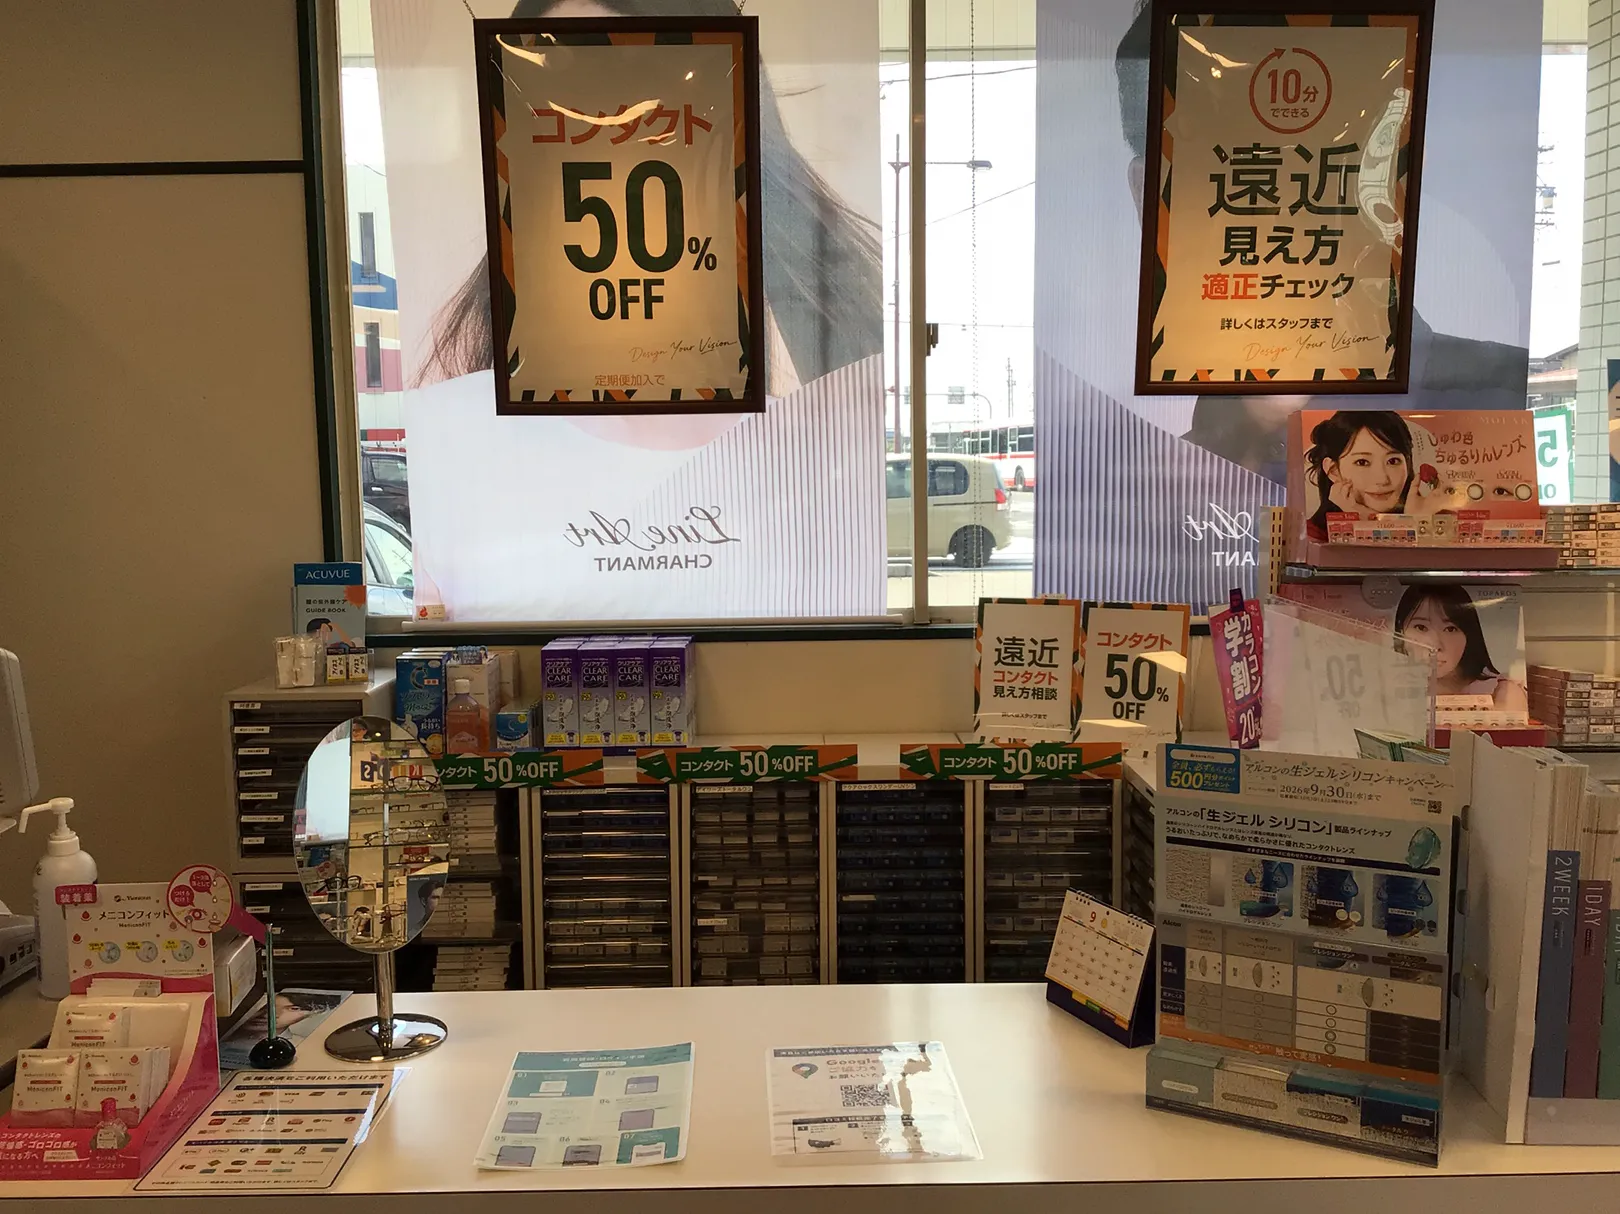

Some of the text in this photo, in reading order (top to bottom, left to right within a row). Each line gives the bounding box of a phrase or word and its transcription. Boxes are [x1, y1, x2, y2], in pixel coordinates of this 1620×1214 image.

[1267, 69, 1319, 104] 10分
[1270, 107, 1311, 119] でできる
[531, 103, 713, 146] コンタクト
[1207, 142, 1362, 218] 遠近
[560, 159, 718, 274] 50%
[1218, 224, 1344, 267] 見え方
[1201, 273, 1355, 301] 適正チェック
[588, 278, 666, 321] OFF
[1220, 316, 1334, 331] 詳しくはスタッフまで
[630, 337, 738, 363] Design Your Vision
[1243, 333, 1381, 362] Design Your Vision
[594, 374, 665, 387] 定期便加入で
[1434, 434, 1527, 465] ちゅるりんレンズ
[305, 568, 351, 580] ACUVUE
[1097, 631, 1173, 651] コンタクト
[993, 636, 1060, 669] 遠近
[1223, 614, 1252, 701] 学割
[1240, 610, 1263, 695] カラコン
[547, 666, 572, 674] CLEAR
[547, 674, 573, 682] CARE
[583, 667, 609, 675] CLEAR
[619, 667, 644, 675] CLEAR
[654, 666, 680, 674] CLEAR
[654, 674, 681, 682] CARE
[993, 670, 1059, 686] コンタクト
[1104, 653, 1170, 703] 50%
[583, 675, 610, 683] CARE
[619, 675, 645, 683] CARE
[993, 685, 1058, 701] 見え方相談
[1112, 701, 1147, 721] OFF
[680, 760, 734, 773] コンタクト
[943, 756, 997, 770] コンタクト
[437, 767, 477, 779] ンタクト
[1245, 763, 1449, 790] アルコンの生ジェルシリコンキャンペーン
[1279, 783, 1383, 803] 2026年9月30日(水)まで
[1552, 855, 1573, 917] 2WEEK
[98, 909, 170, 921] メニコンフィット
[1089, 910, 1097, 923] 9
[826, 1058, 881, 1067] Google
[1, 1132, 62, 1140] コンタクトレンズの
[0, 1151, 39, 1160] になる方へ
